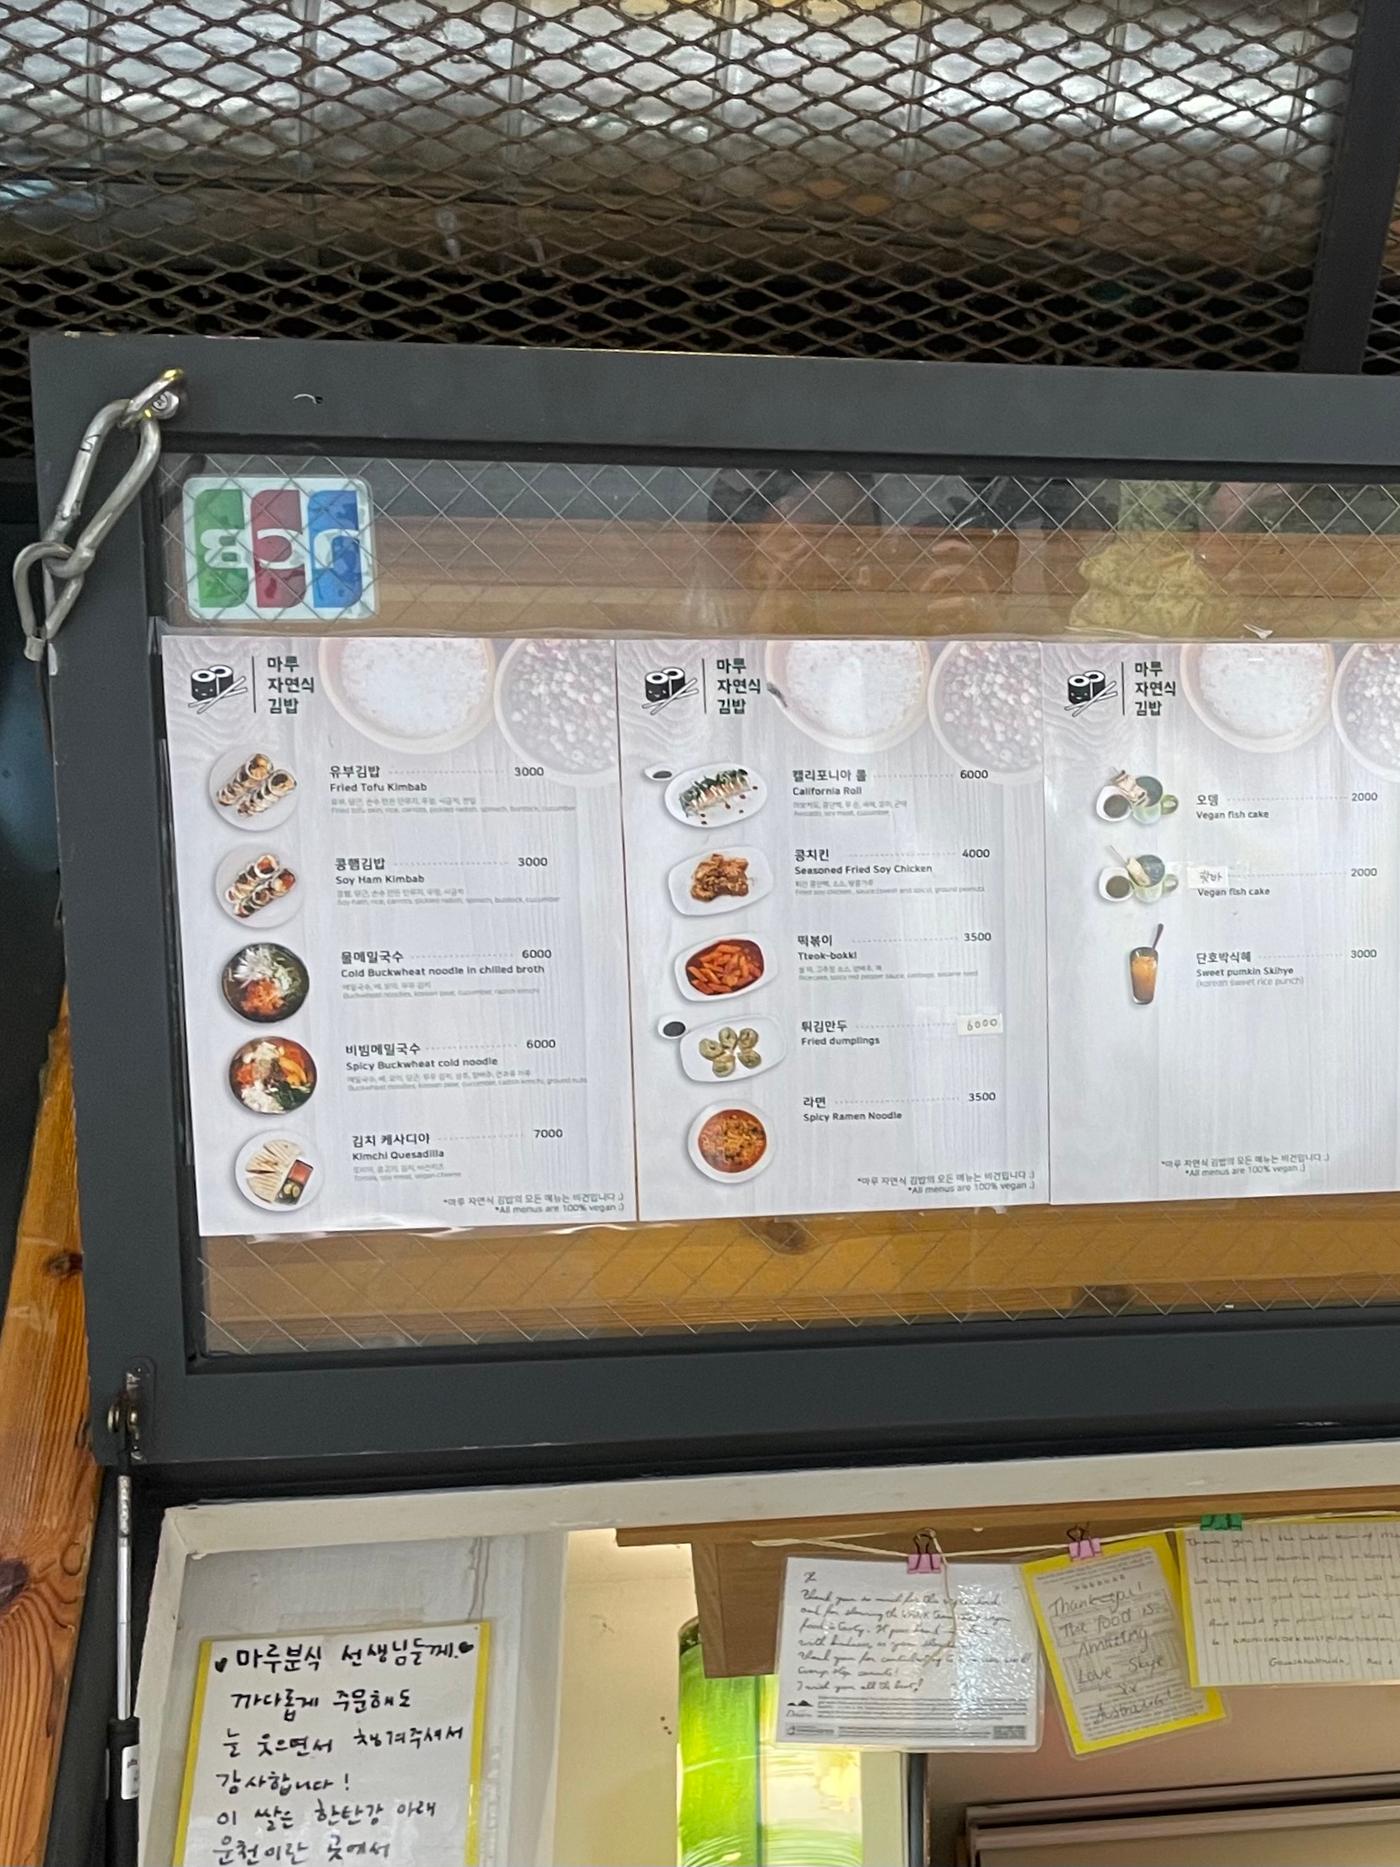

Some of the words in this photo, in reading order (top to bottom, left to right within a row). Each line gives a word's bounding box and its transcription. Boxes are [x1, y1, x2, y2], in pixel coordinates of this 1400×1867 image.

[267, 656, 300, 672] 마루
[717, 658, 746, 674] 마루
[1135, 661, 1163, 677] 마루
[268, 677, 314, 693] 자연식
[717, 678, 760, 694] 자연식
[1135, 681, 1176, 696] 자연식
[268, 697, 299, 714] 김밥
[718, 698, 746, 714] 김밥
[1135, 701, 1162, 716] 김밥
[330, 765, 380, 778] 유부김밥
[514, 767, 544, 776] 3000
[792, 769, 851, 783] 캘리포니아
[856, 769, 867, 782] 롤
[960, 770, 988, 780] 6000
[330, 782, 357, 792] Fried
[361, 782, 385, 792] Tofu
[387, 782, 427, 792] Kimbab
[792, 786, 840, 795] California
[843, 785, 862, 795] Roll
[1351, 792, 1378, 801] 2000
[1196, 811, 1225, 820] Vegan
[1228, 810, 1245, 819] fish
[1248, 810, 1269, 818] cake
[794, 849, 829, 862] 콩치킨
[962, 849, 990, 859] 4000
[335, 858, 385, 871] 콩햄김밥
[518, 857, 547, 867] 3000
[795, 866, 842, 875] Seasoned
[845, 864, 871, 874] Fried
[873, 864, 891, 875] Soy
[894, 863, 932, 873] Chicken
[1351, 868, 1377, 877] 2000
[336, 875, 355, 886] Soy
[358, 875, 382, 884] Ham
[385, 875, 424, 884] Kimbab
[1197, 888, 1226, 898] Vegan
[1228, 887, 1246, 896] fish
[1249, 887, 1270, 895] cake
[798, 934, 832, 947] 떡볶이
[963, 932, 992, 942] 3500
[522, 949, 552, 958] 6000
[798, 952, 857, 960] Tteok-bokki
[1196, 951, 1251, 964] 단호박식혜
[1350, 949, 1377, 958] 3000
[341, 968, 364, 977] Cold
[368, 966, 426, 977] Buckwheat
[428, 966, 463, 975] noodle
[467, 966, 476, 974] in
[479, 964, 513, 975] chilled
[516, 964, 544, 974] broth
[1197, 968, 1224, 977] Sweet
[1227, 968, 1260, 978] pumkin
[801, 1020, 847, 1033] 튀김만두
[346, 1042, 420, 1057] 비빔메밀국수
[526, 1039, 555, 1048] 6000
[801, 1037, 827, 1045] Fried
[829, 1036, 880, 1047] dumplings
[346, 1061, 374, 1072] Spicy
[378, 1059, 435, 1069] Buckwheat
[438, 1058, 460, 1067] cold
[463, 1057, 498, 1066] noodle
[803, 1096, 826, 1108] 라면
[968, 1092, 996, 1101] 3500
[803, 1113, 830, 1123] Spicy
[832, 1112, 865, 1121] Ramen
[868, 1111, 902, 1120] Noodle
[352, 1135, 376, 1148] 김치
[381, 1133, 429, 1146] 케사디아
[534, 1129, 563, 1138] 7000
[352, 1151, 388, 1160] Kimchi
[391, 1149, 444, 1159] Quesadilla
[237, 1644, 321, 1673] 마루분식
[231, 1689, 318, 1722] 까다롭게
[333, 1689, 410, 1713] 주문해도
[223, 1728, 240, 1757] 눈
[258, 1734, 332, 1757] 웃으면서
[217, 1811, 236, 1825] 이
[255, 1806, 293, 1831] 쌀은
[315, 1798, 383, 1826] 한탄강
[397, 1801, 436, 1817] 아래
